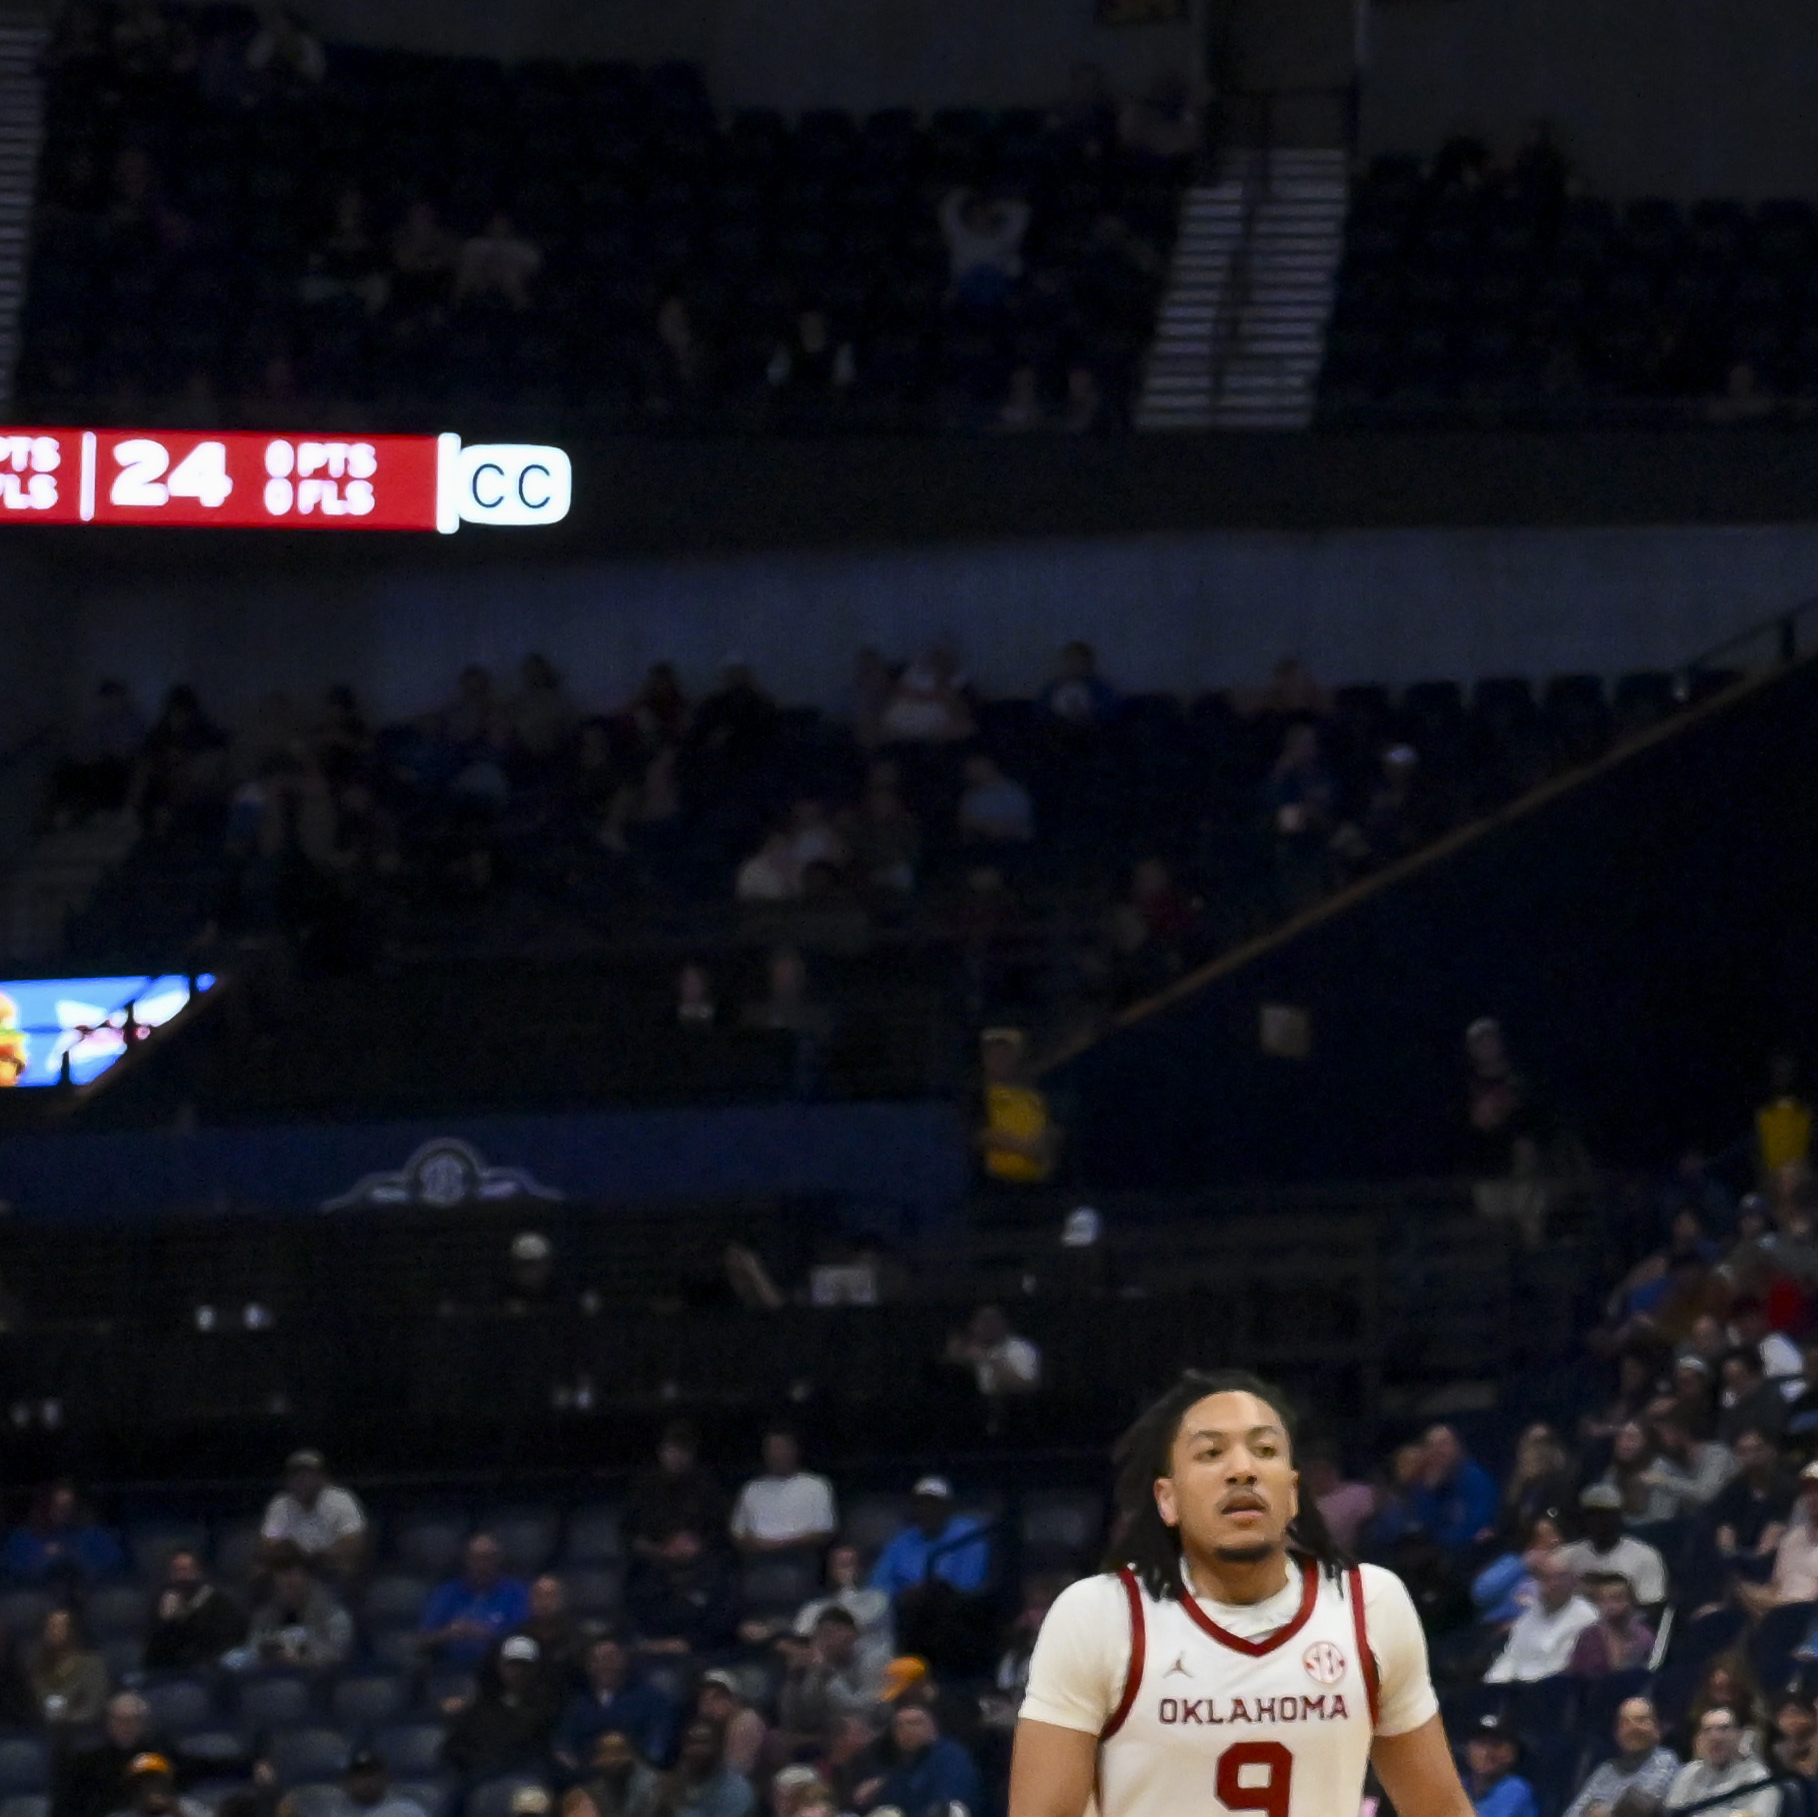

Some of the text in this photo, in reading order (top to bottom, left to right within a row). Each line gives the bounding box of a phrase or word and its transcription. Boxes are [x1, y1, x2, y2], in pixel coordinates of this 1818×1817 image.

[109, 439, 233, 507] 24
[298, 442, 377, 479] PTS
[298, 480, 375, 516] FLS
[471, 463, 552, 510] CC
[1158, 1694, 1349, 1725] OKLAHOMA
[1216, 1741, 1294, 1817] 9
